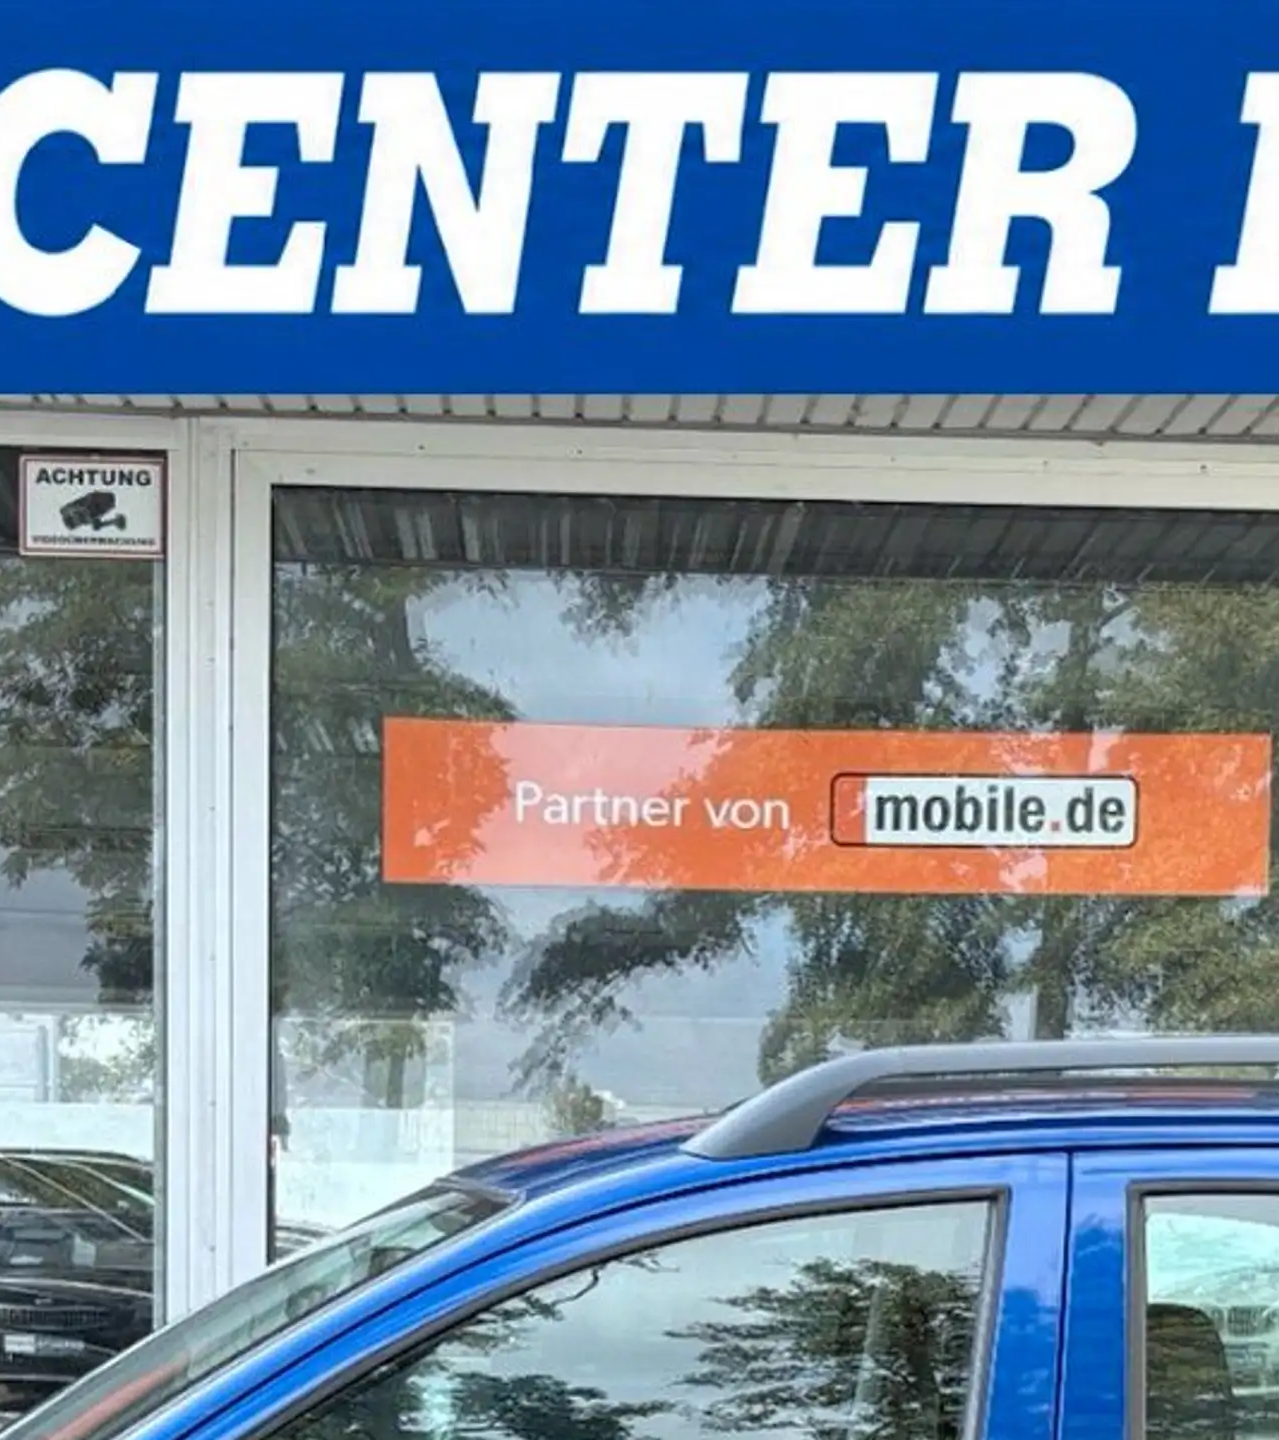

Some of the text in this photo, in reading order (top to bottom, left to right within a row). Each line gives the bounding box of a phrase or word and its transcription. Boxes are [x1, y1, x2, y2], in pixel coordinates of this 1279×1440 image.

[35, 467, 152, 486] ACHTUNG
[515, 780, 1127, 833] Partner von mobile.de
